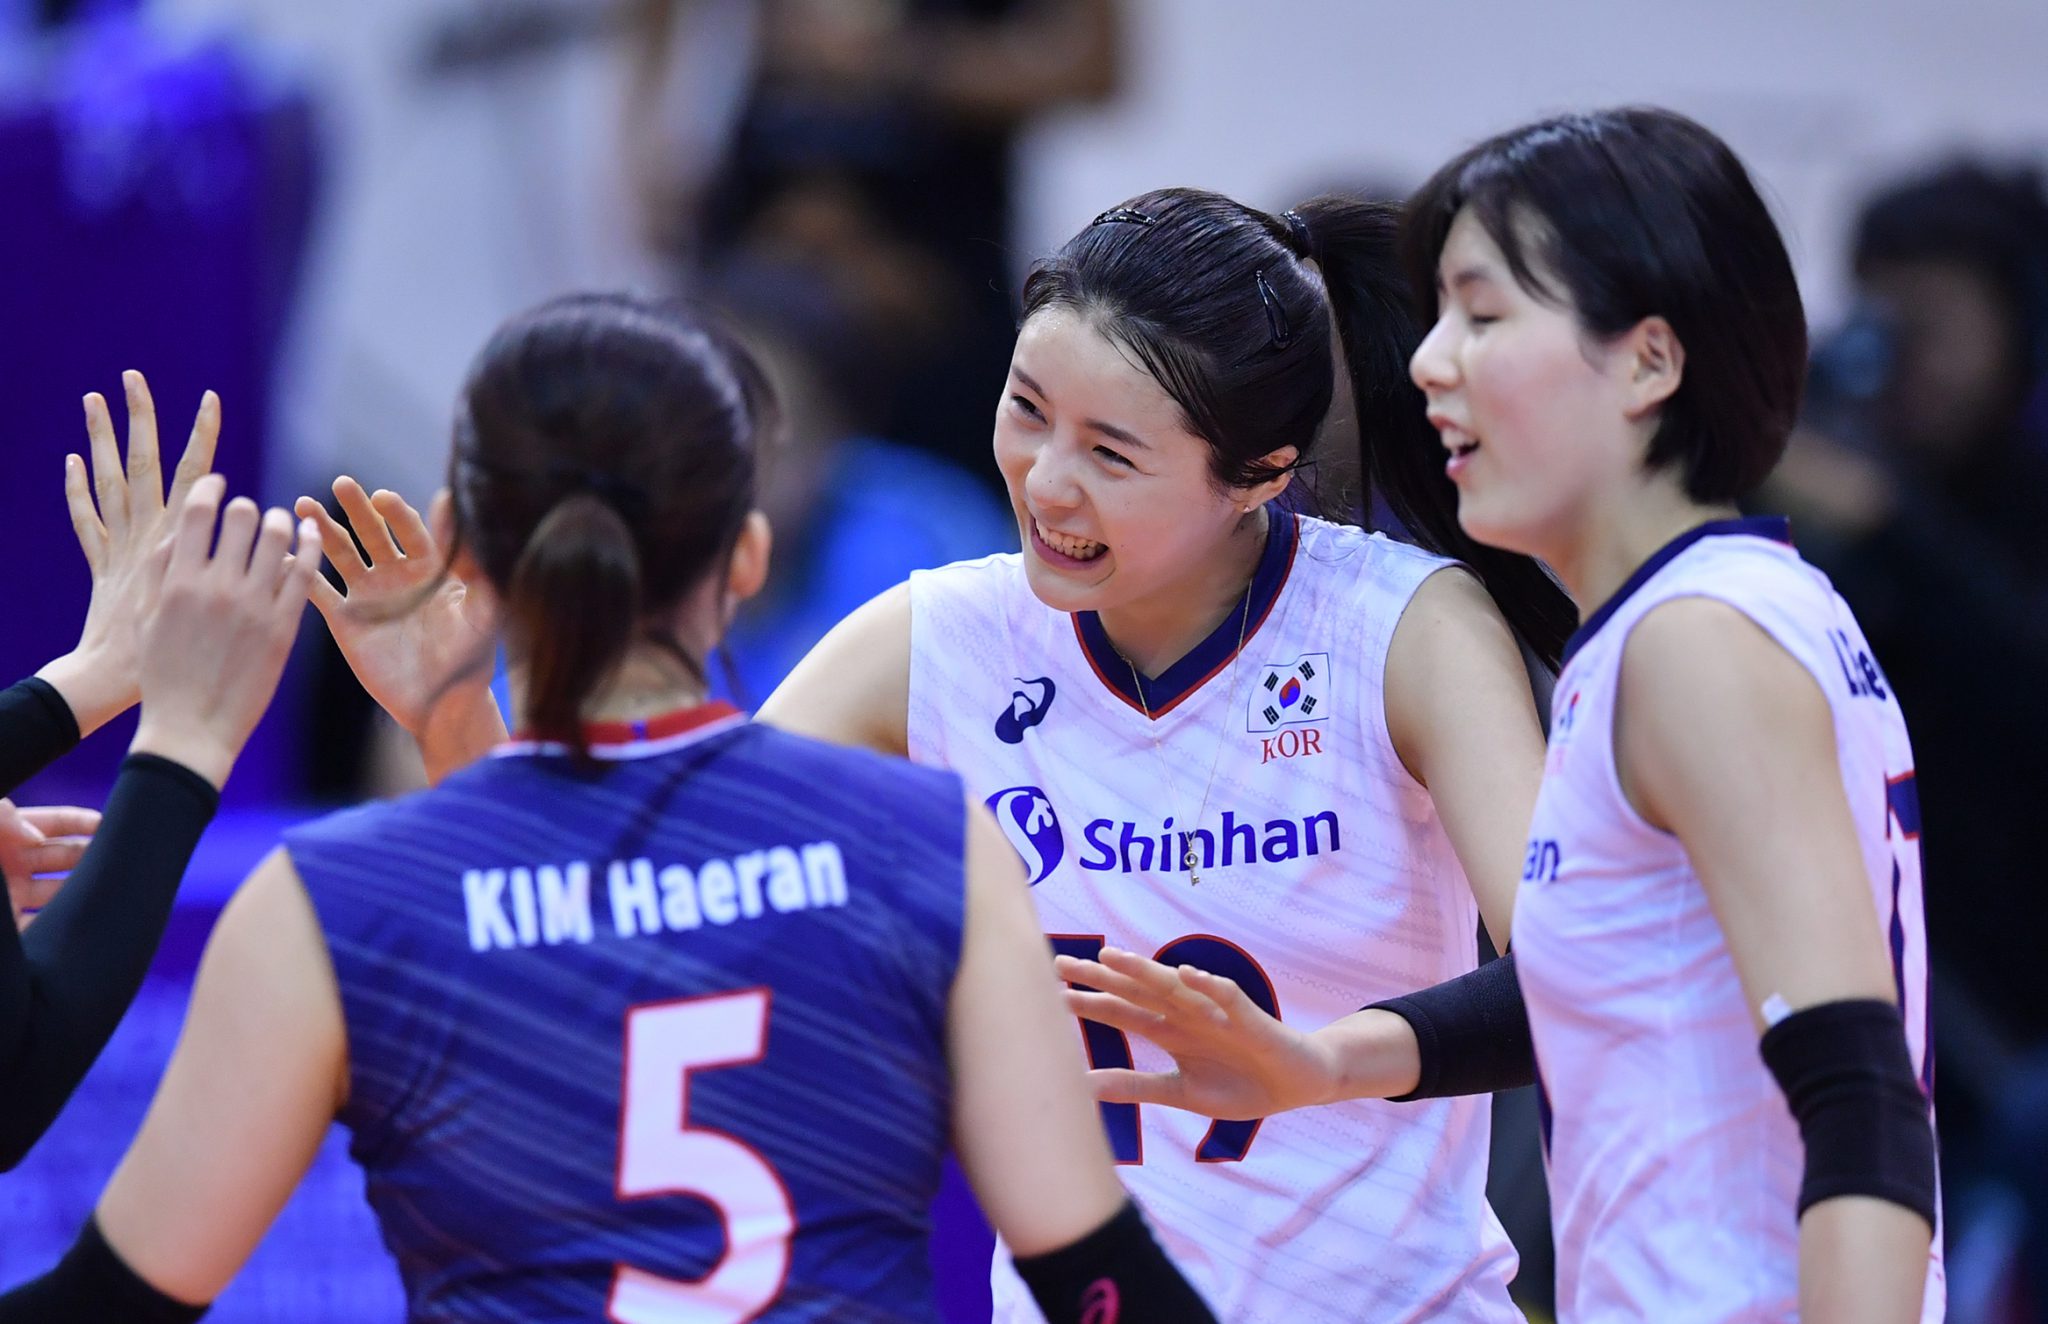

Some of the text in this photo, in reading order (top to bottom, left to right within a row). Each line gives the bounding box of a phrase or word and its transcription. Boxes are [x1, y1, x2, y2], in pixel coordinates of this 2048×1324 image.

[1261, 728, 1323, 765] KOR
[1080, 810, 1341, 874] Shinhan
[463, 841, 848, 952] KIM Haeran
[606, 986, 797, 1324] 5
